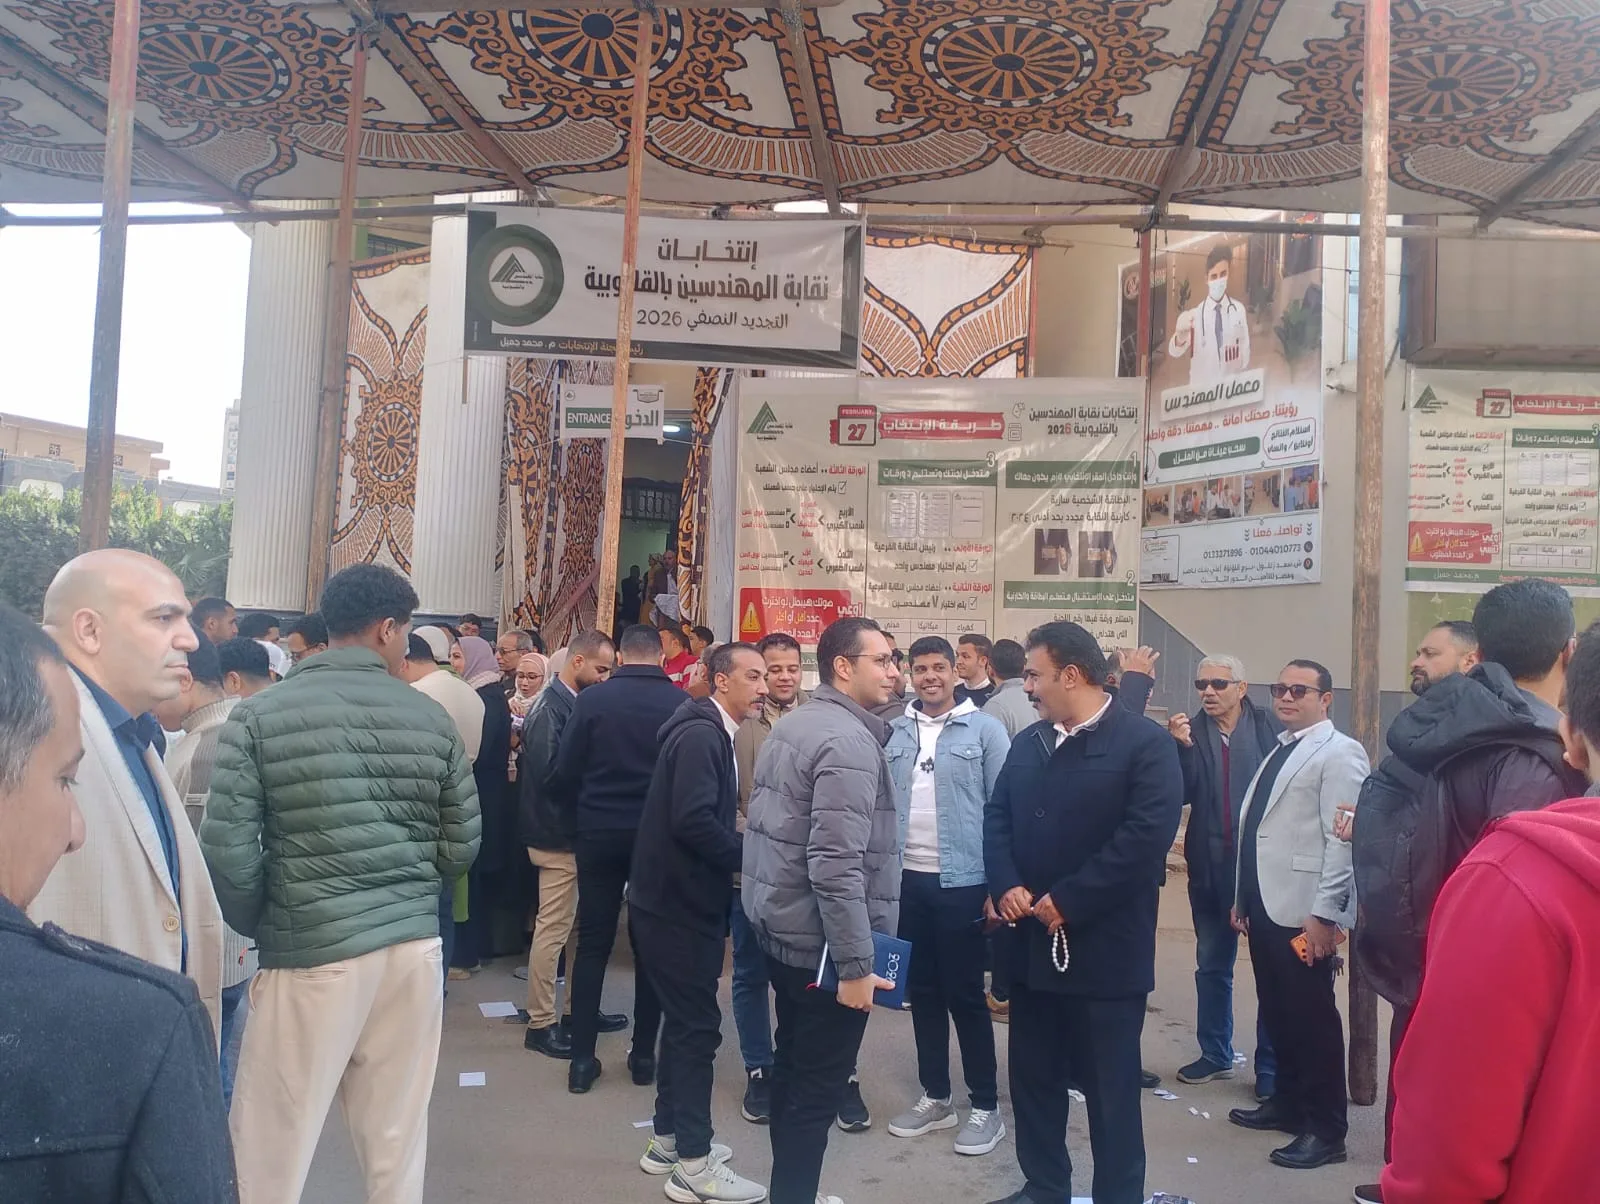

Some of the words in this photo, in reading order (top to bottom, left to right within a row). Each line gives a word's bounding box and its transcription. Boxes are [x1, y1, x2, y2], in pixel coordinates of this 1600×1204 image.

[658, 238, 757, 269] إنتخابات
[677, 273, 777, 302] المهندسين
[784, 274, 828, 307] نقابة
[637, 309, 682, 326] 2026
[687, 310, 737, 331] النصفي
[741, 313, 788, 330] التجديد
[500, 336, 520, 348] جميل
[522, 339, 543, 347] محمد
[1226, 378, 1260, 399] معمل
[1164, 383, 1223, 413] المهندس
[567, 412, 611, 424] ENTRANCE
[625, 409, 659, 429] الدخو
[1029, 407, 1076, 422] المهندسين
[1079, 407, 1100, 421] نقابة
[1102, 405, 1138, 424] إنتخابات
[1222, 409, 1243, 427] أمانة
[1244, 409, 1270, 423] صحتك
[848, 424, 867, 441] 27
[883, 419, 936, 434] الإنتخاب
[940, 419, 1002, 434] طريقة
[1048, 423, 1072, 435] 2026
[1074, 422, 1118, 437] بالقليوبية
[1167, 427, 1182, 438] دقة
[1592, 423, 1599, 436] 3
[987, 451, 996, 468] 3
[1130, 451, 1138, 468] 1
[1072, 494, 1102, 506] الشخصية
[1051, 513, 1064, 523] بحد
[1066, 513, 1084, 523] مجدد
[1087, 512, 1108, 525] النقابة
[1127, 569, 1136, 587] 2
[789, 596, 813, 609] هيبطل
[813, 597, 834, 611] صوتك
[806, 614, 820, 623] عدد
